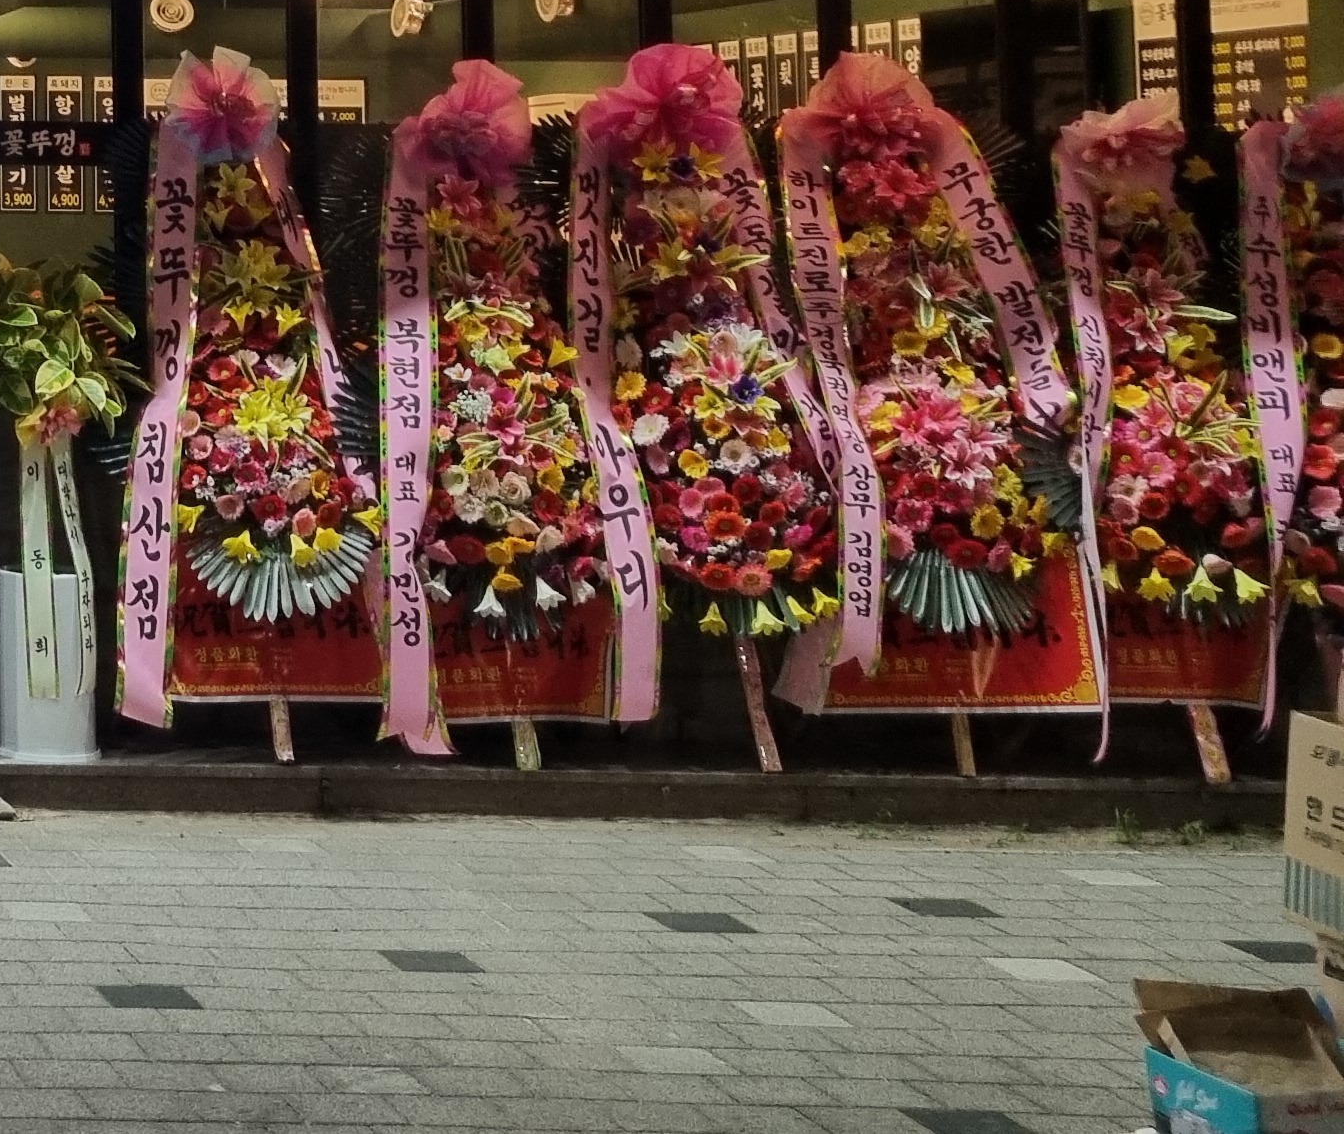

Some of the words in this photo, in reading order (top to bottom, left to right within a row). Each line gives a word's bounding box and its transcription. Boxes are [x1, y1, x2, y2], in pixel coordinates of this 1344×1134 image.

[0, 129, 76, 156] 꽃뚜껑
[4, 192, 32, 207] 3,900
[52, 193, 80, 208] 4,900
[943, 160, 1015, 266] 무궁한
[153, 177, 195, 382] 꽃뚜껑
[384, 196, 425, 299] 꽃뚜껑
[1063, 201, 1093, 298] 꽃뚜껑
[393, 451, 421, 504] 대표
[844, 463, 877, 518] 상무
[126, 420, 171, 642] 침산점
